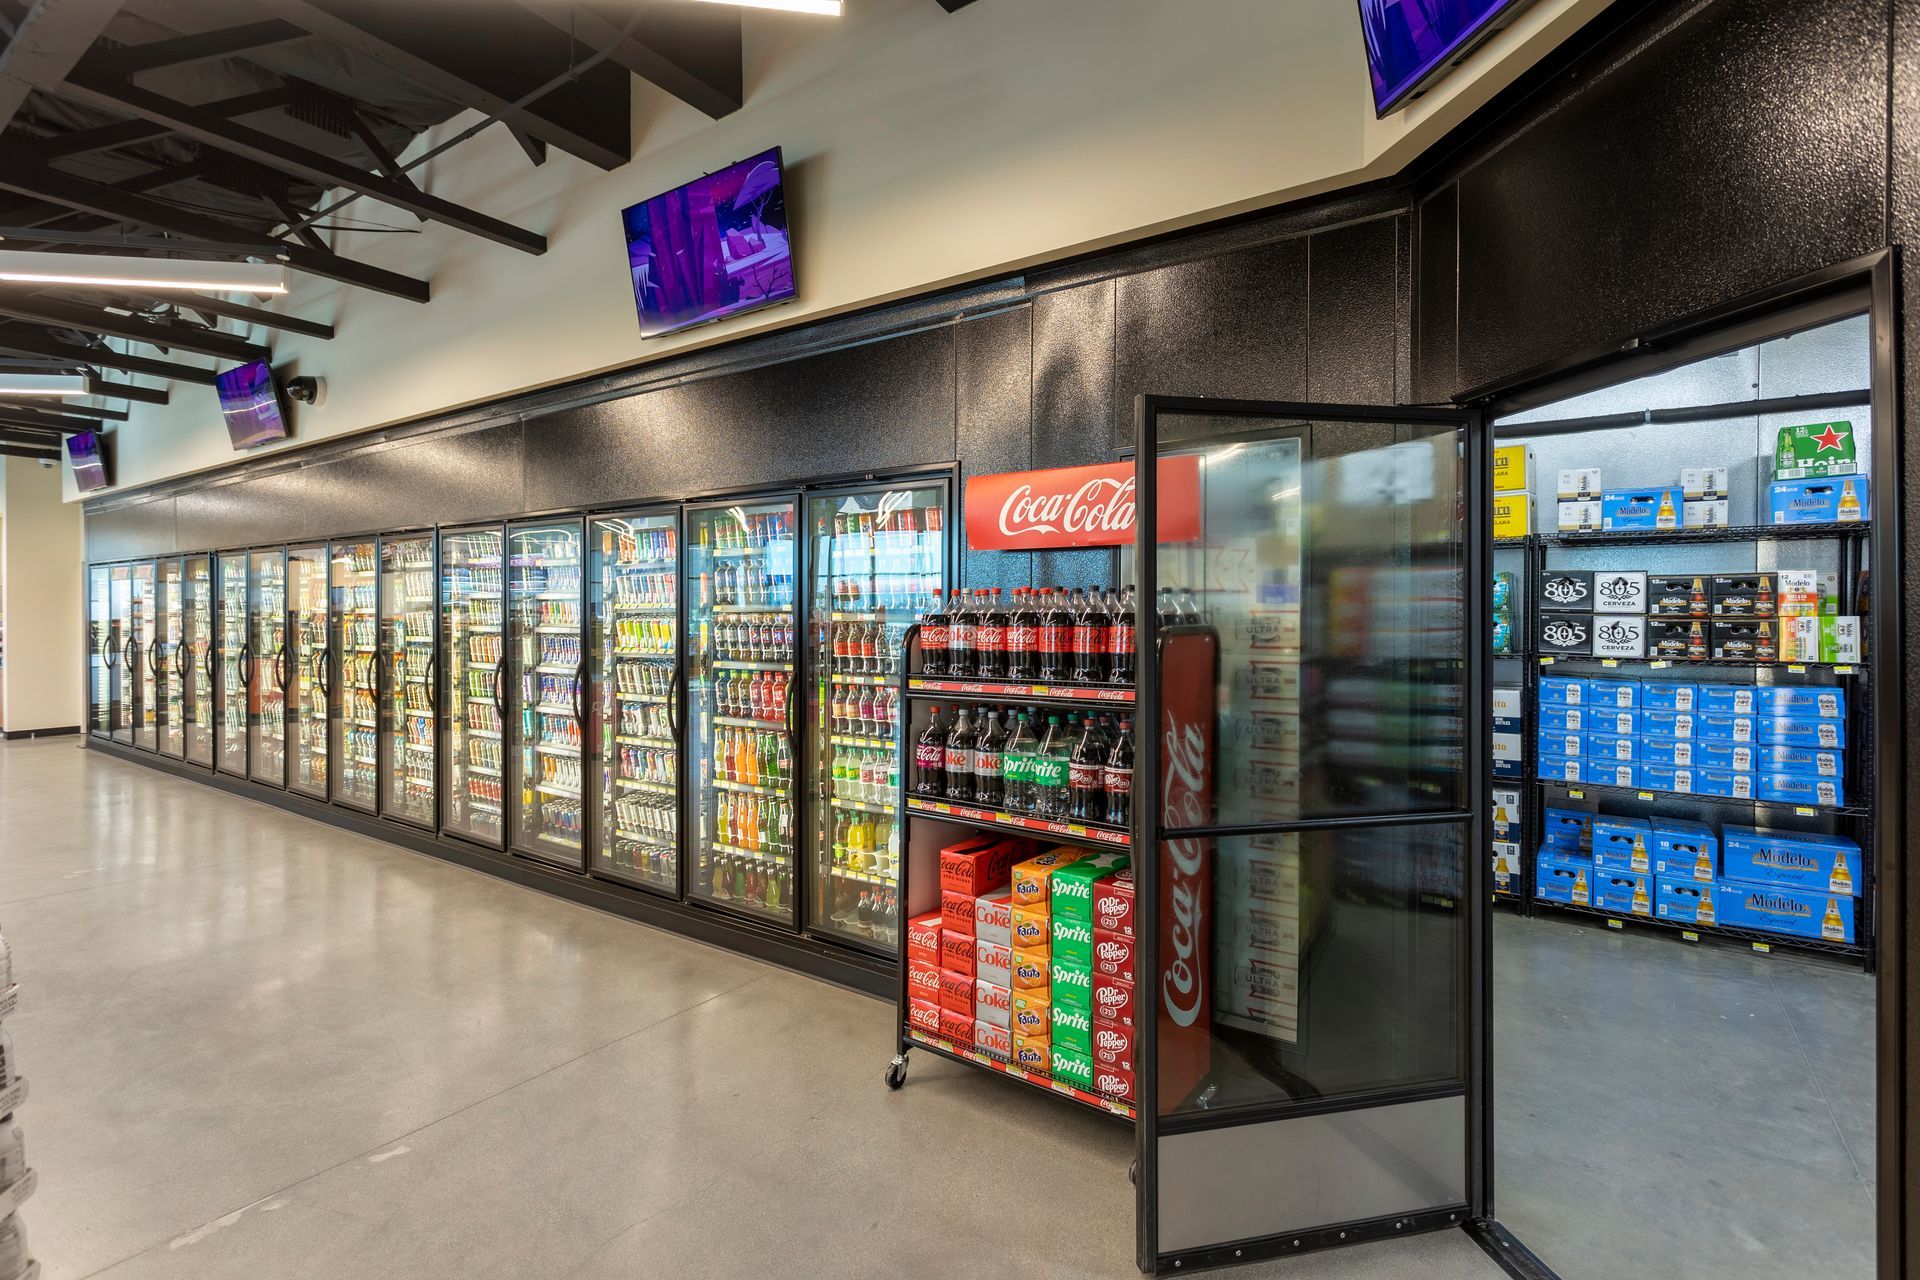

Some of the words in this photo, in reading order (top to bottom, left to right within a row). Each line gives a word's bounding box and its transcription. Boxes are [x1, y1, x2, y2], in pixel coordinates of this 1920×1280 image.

[1796, 456, 1855, 468] Hein
[999, 477, 1136, 536] Coca-Cola
[1793, 497, 1825, 507] Modelo
[1619, 506, 1648, 515] Modelo
[1543, 582, 1588, 598] 805
[1599, 581, 1641, 596] 805
[1662, 597, 1685, 605] Modelo
[1725, 597, 1748, 605] Modelo
[1245, 625, 1280, 634] ULTRA
[1543, 625, 1587, 642] 805
[1598, 625, 1640, 641] 805
[1246, 676, 1281, 685] ULTRA
[961, 683, 984, 693] Coca-Cola
[1004, 685, 1028, 695] Coca-Cola
[1049, 687, 1074, 698] Coca-Cola
[1097, 690, 1125, 701] Coca-Cola
[1779, 694, 1809, 703] Modelo
[1246, 726, 1281, 736] ULTRA
[1779, 723, 1809, 732] Modelo
[1778, 751, 1808, 760] Modelo
[1778, 780, 1808, 789] Modelo
[960, 807, 983, 819] Coca-Cola
[1097, 831, 1123, 843] Coca-Cola
[1759, 848, 1811, 866] Modelo
[1163, 709, 1206, 1027] Coca-Cola
[1016, 882, 1039, 894] Fanta
[1052, 878, 1090, 899] Sprite
[1720, 885, 1733, 893] 24
[1832, 879, 1852, 888] Modelo
[1101, 898, 1127, 916] Pepper
[1108, 897, 1120, 906] Dr
[1751, 893, 1803, 912] Modelo
[976, 906, 1010, 929] Coke
[1017, 925, 1040, 937] Fanta
[1053, 922, 1091, 943] Sprite
[1123, 926, 1133, 935] 12
[1245, 924, 1280, 938] ULTRA
[1824, 925, 1843, 935] Modelo
[1101, 943, 1127, 961] Pepper
[1108, 942, 1119, 951] Dr
[977, 946, 1011, 970] Coke
[1017, 967, 1040, 979] Fanta
[1053, 965, 1090, 988] Sprite
[1123, 971, 1132, 980] 12
[1245, 972, 1280, 988] ULTRA
[1099, 988, 1126, 1006] Pepper
[1107, 987, 1119, 996] Dr
[976, 987, 1010, 1011] Coke
[1017, 1013, 1040, 1026] Fanta
[1053, 1008, 1090, 1032] Sprite
[1122, 1017, 1132, 1026] 12
[976, 1028, 1010, 1053] Coke
[1100, 1032, 1125, 1050] Pepper
[1107, 1031, 1119, 1041] Dr
[1018, 1050, 1042, 1063] Fanta
[1053, 1053, 1091, 1078] Sprite
[1121, 1061, 1131, 1070] 12
[1100, 1076, 1127, 1094] Pepper
[1108, 1075, 1120, 1085] Dr
